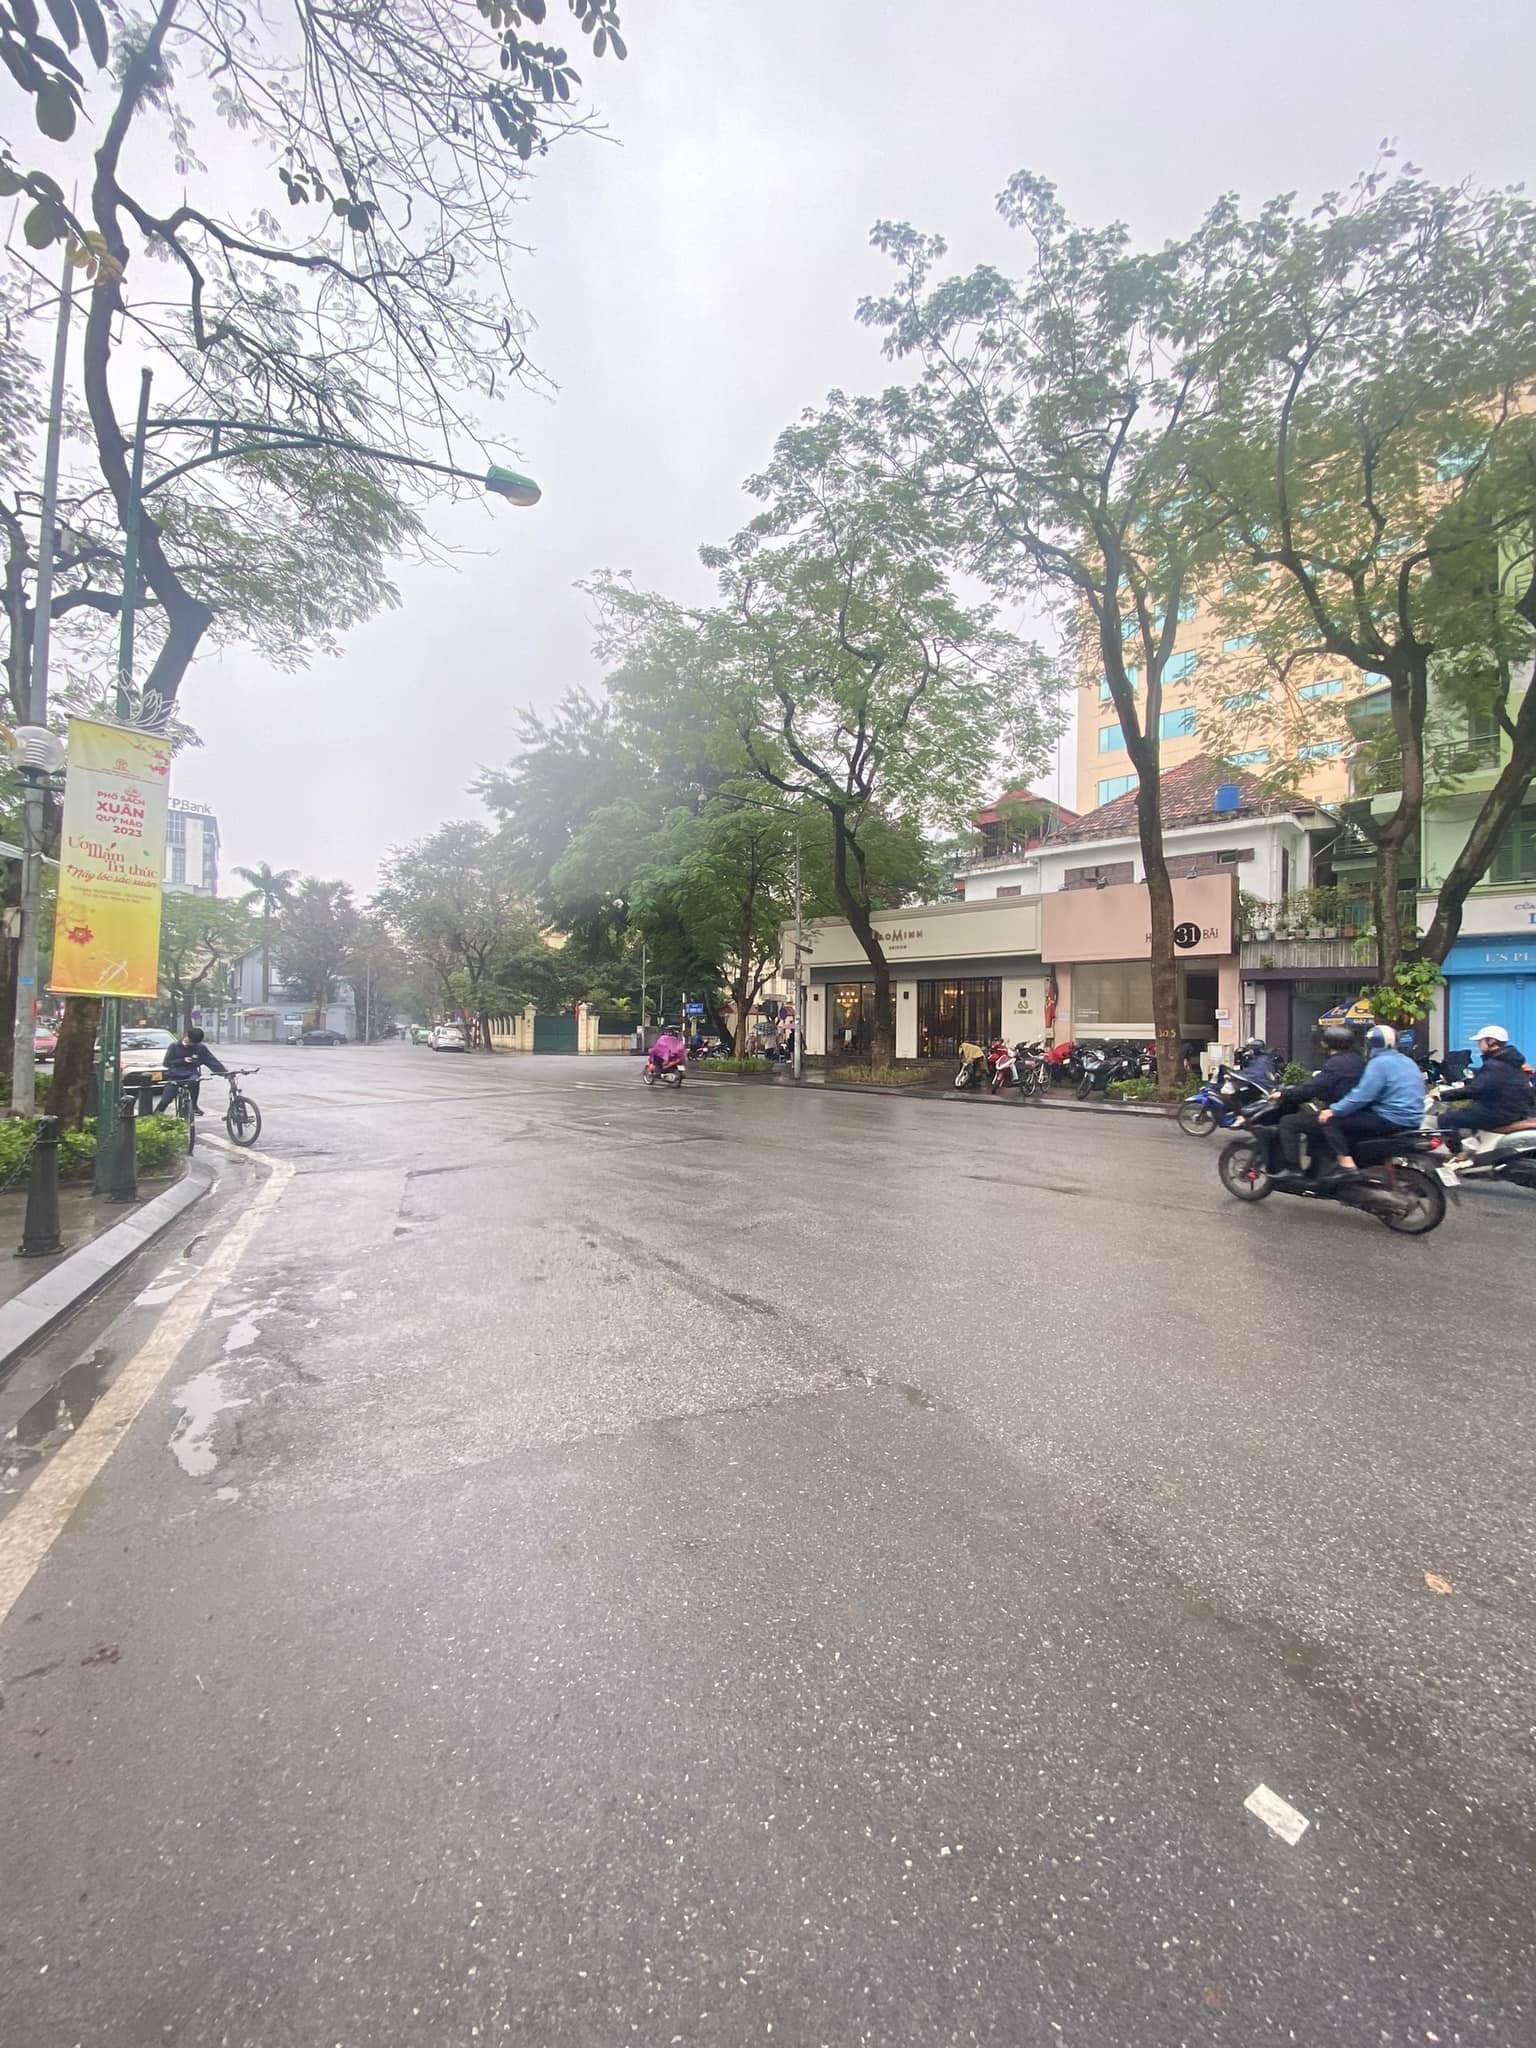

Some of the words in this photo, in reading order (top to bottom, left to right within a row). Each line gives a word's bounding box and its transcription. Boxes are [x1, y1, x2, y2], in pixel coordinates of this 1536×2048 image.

[96, 801, 145, 819] XUÂN
[112, 825, 143, 838] 2023
[1175, 926, 1198, 944] 31
[1017, 1000, 1029, 1009] 63
